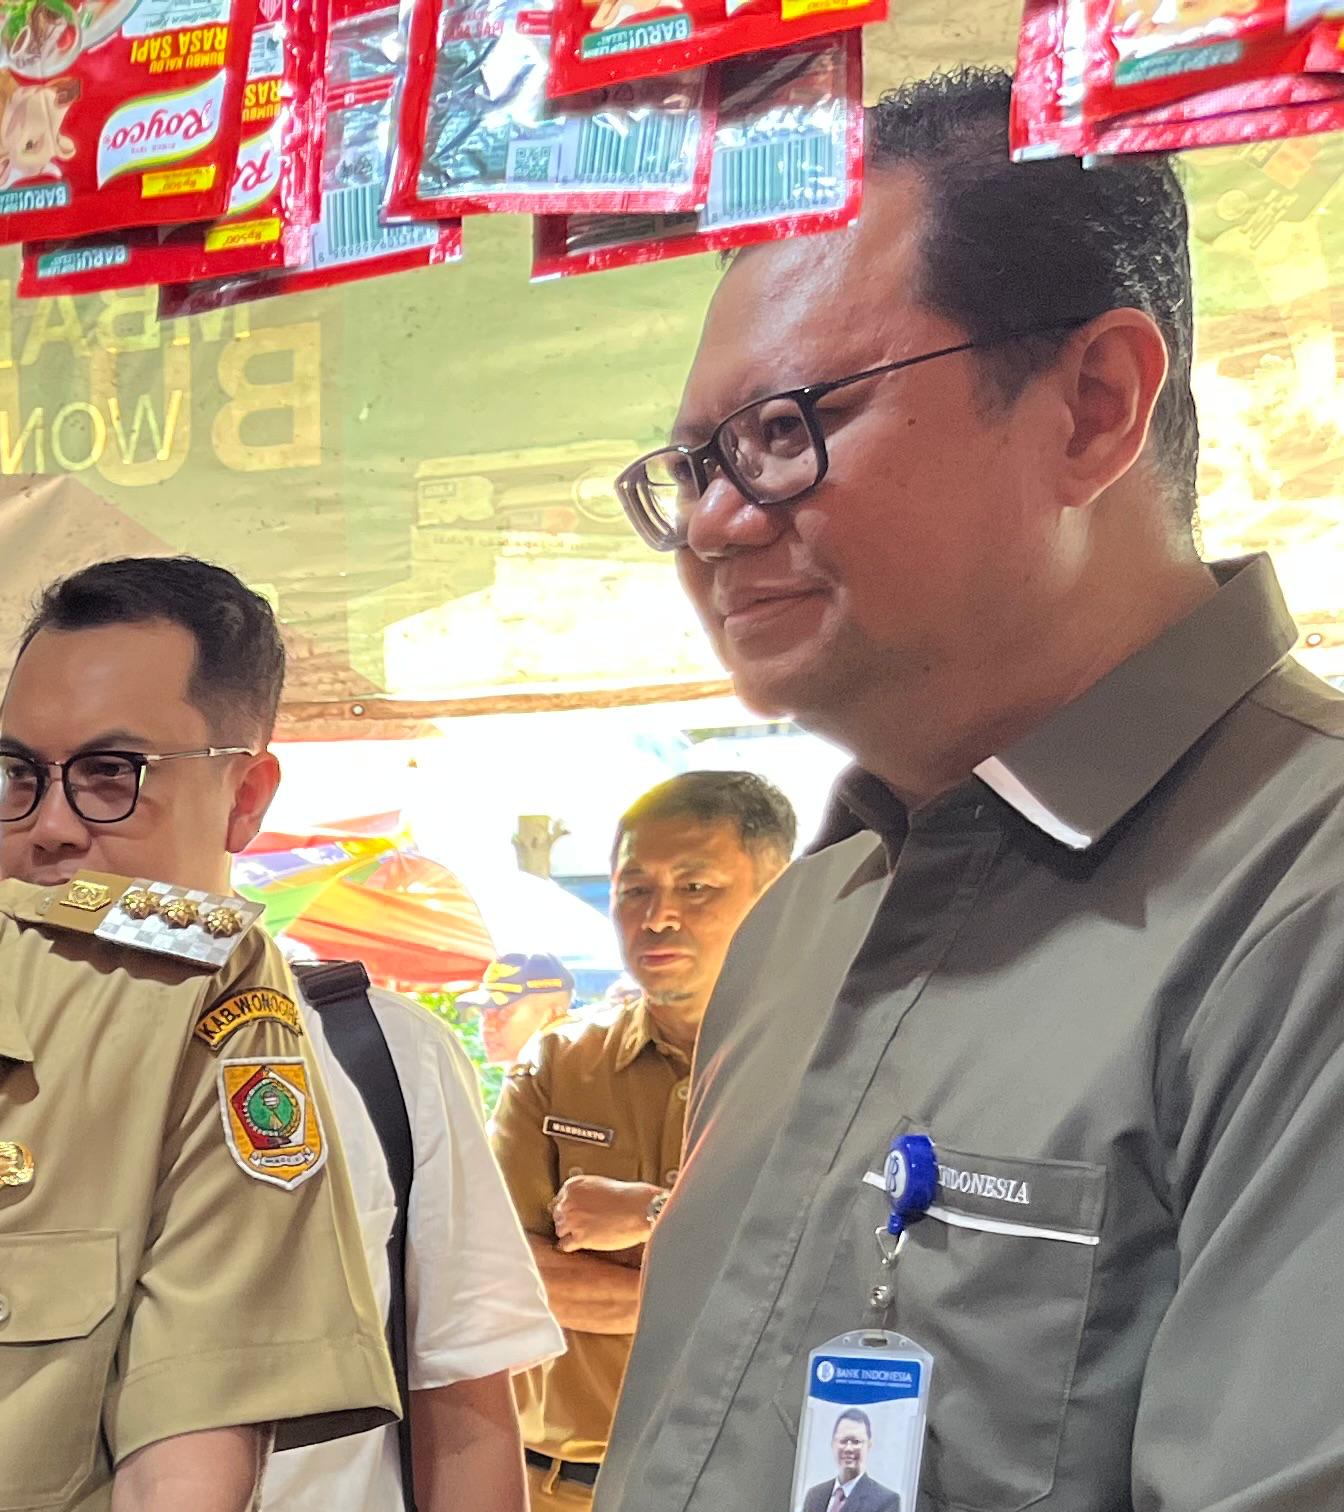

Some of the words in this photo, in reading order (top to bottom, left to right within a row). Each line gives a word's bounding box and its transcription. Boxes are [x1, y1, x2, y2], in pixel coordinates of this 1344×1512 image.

[179, 27, 227, 54] RASA
[628, 16, 689, 44] BARU!
[131, 35, 172, 63] SAPI
[186, 51, 224, 67] BUMBU
[149, 56, 183, 73] KALDU
[244, 80, 281, 102] RAS
[241, 103, 281, 120] BUMBU
[110, 97, 213, 149] Royco
[161, 178, 196, 192] Rp500
[19, 186, 66, 209] BARU!
[225, 230, 262, 243] Rp500
[77, 245, 125, 271] BARU!
[938, 1165, 1029, 1204] INDONESIA
[836, 1368, 860, 1379] BANK
[862, 1370, 912, 1382] INDONESIA
